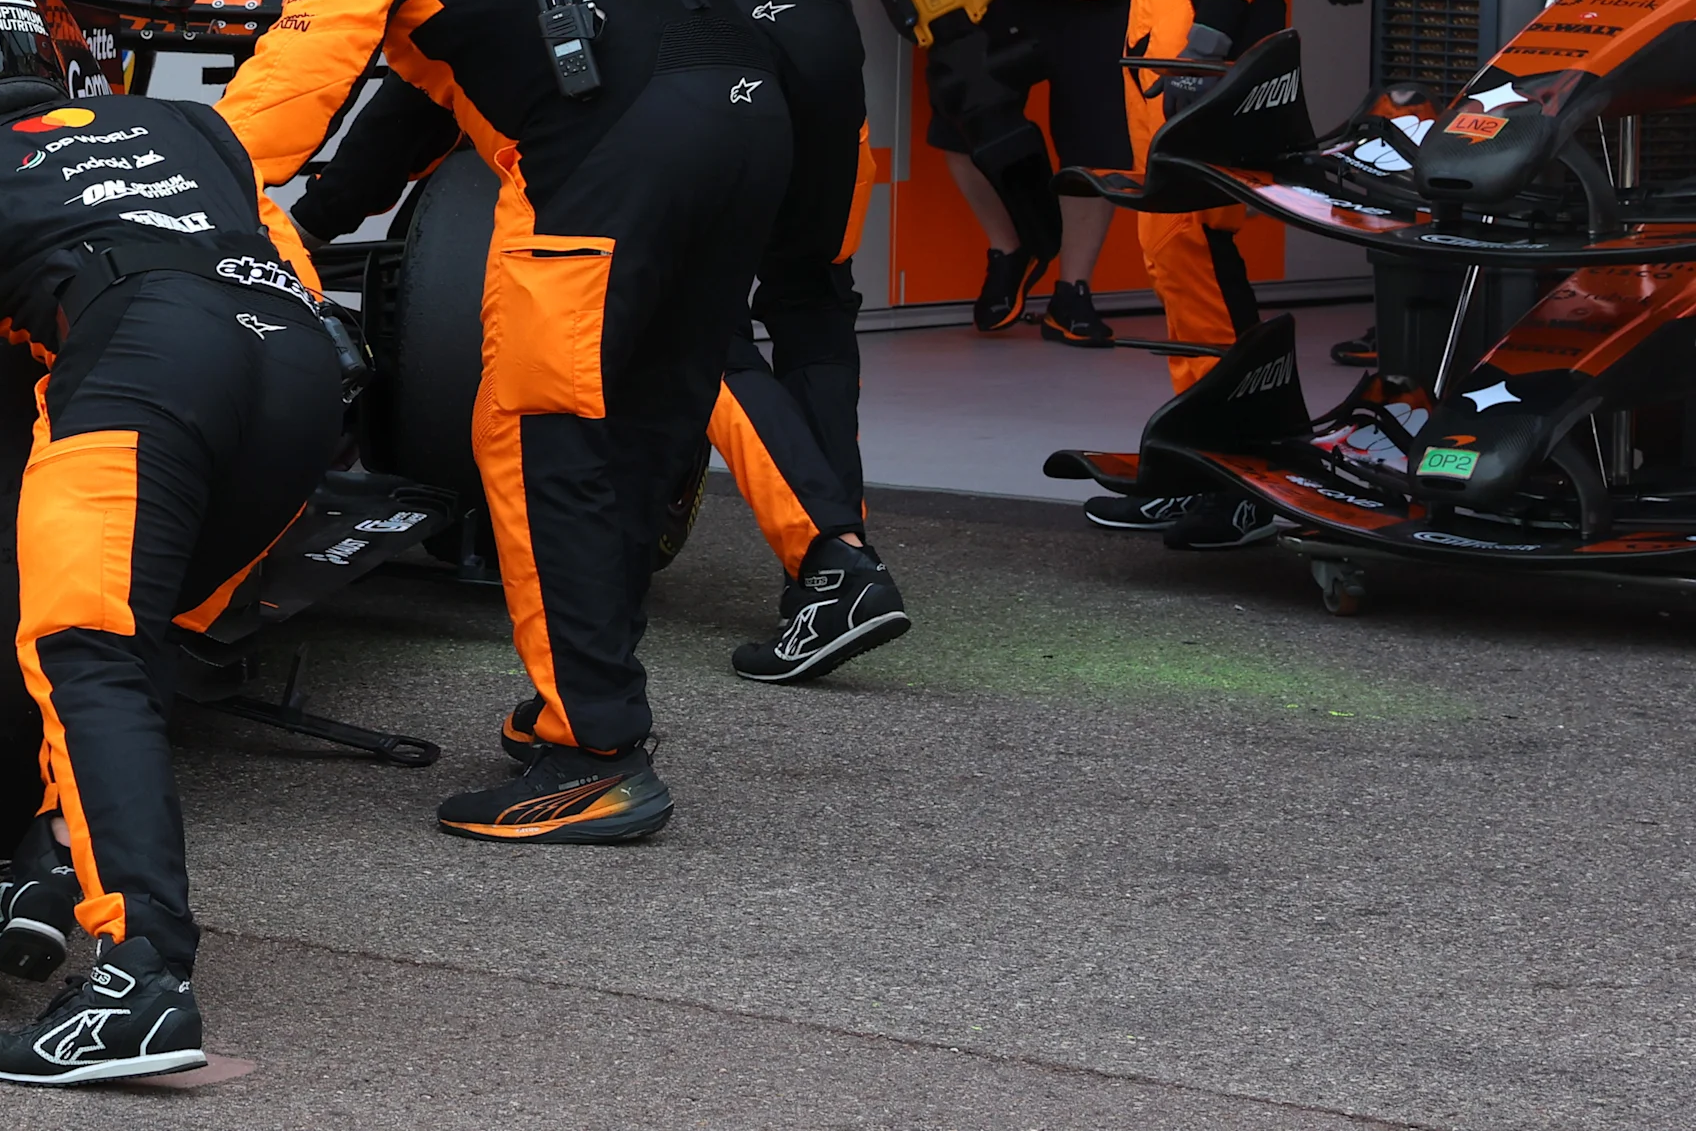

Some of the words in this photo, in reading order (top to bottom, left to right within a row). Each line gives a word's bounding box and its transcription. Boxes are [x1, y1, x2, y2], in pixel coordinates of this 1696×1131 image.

[1455, 118, 1500, 135] LN2
[45, 134, 79, 154] DP
[78, 126, 149, 145] WORLD
[61, 151, 132, 182] Android
[131, 174, 185, 194] OPTIMUM
[1427, 453, 1474, 472] OP2
